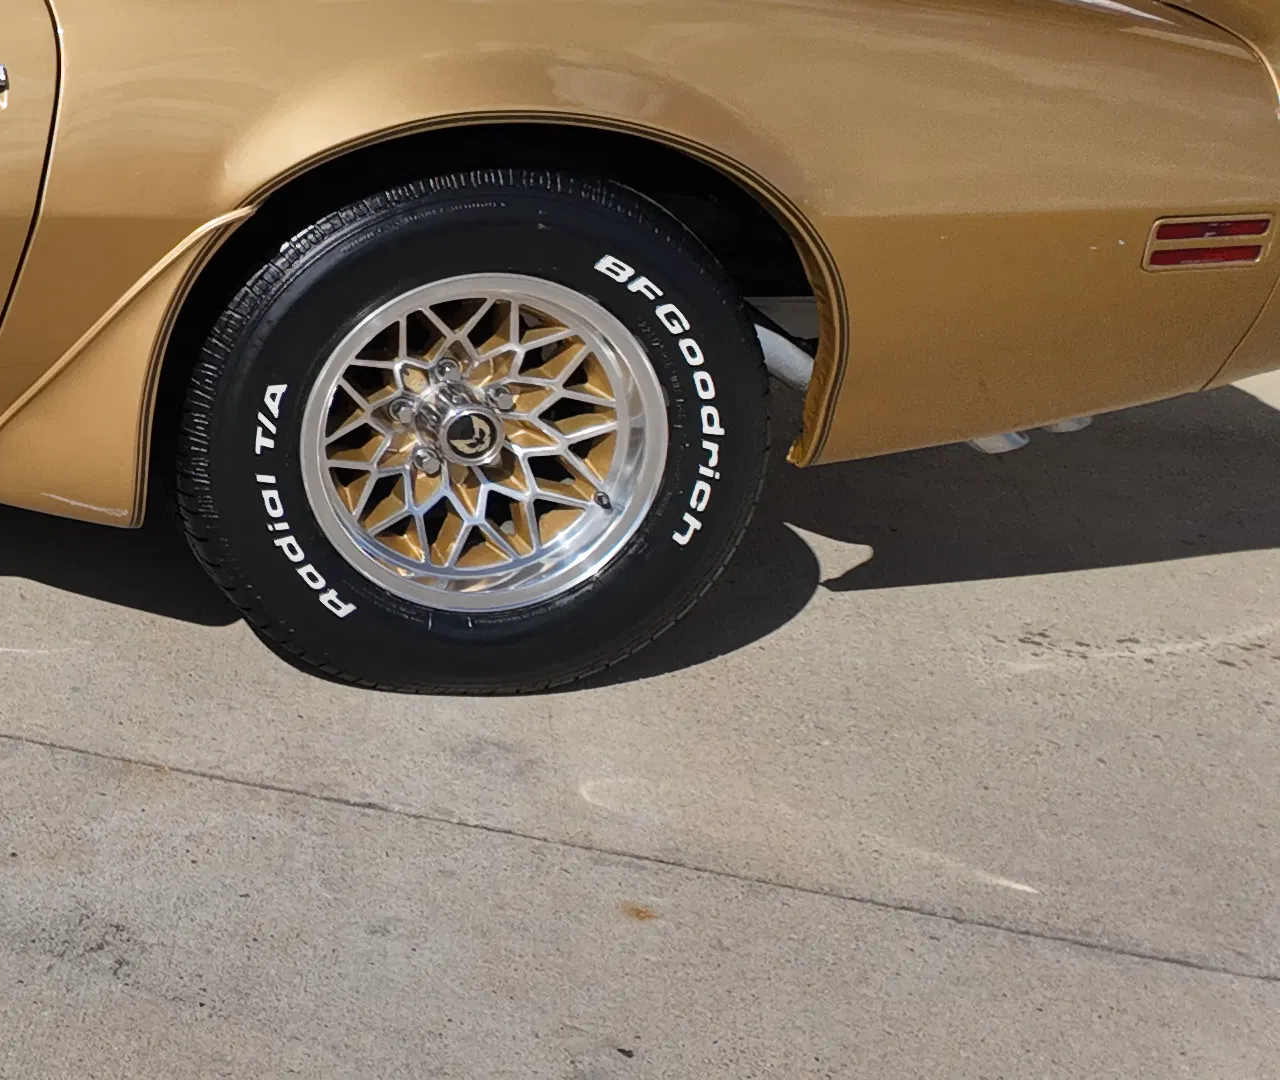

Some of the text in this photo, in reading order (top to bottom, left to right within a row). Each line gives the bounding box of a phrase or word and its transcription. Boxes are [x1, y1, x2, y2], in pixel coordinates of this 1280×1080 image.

[254, 382, 357, 619] Radial T/A
[593, 254, 726, 547] BFGoodrich
